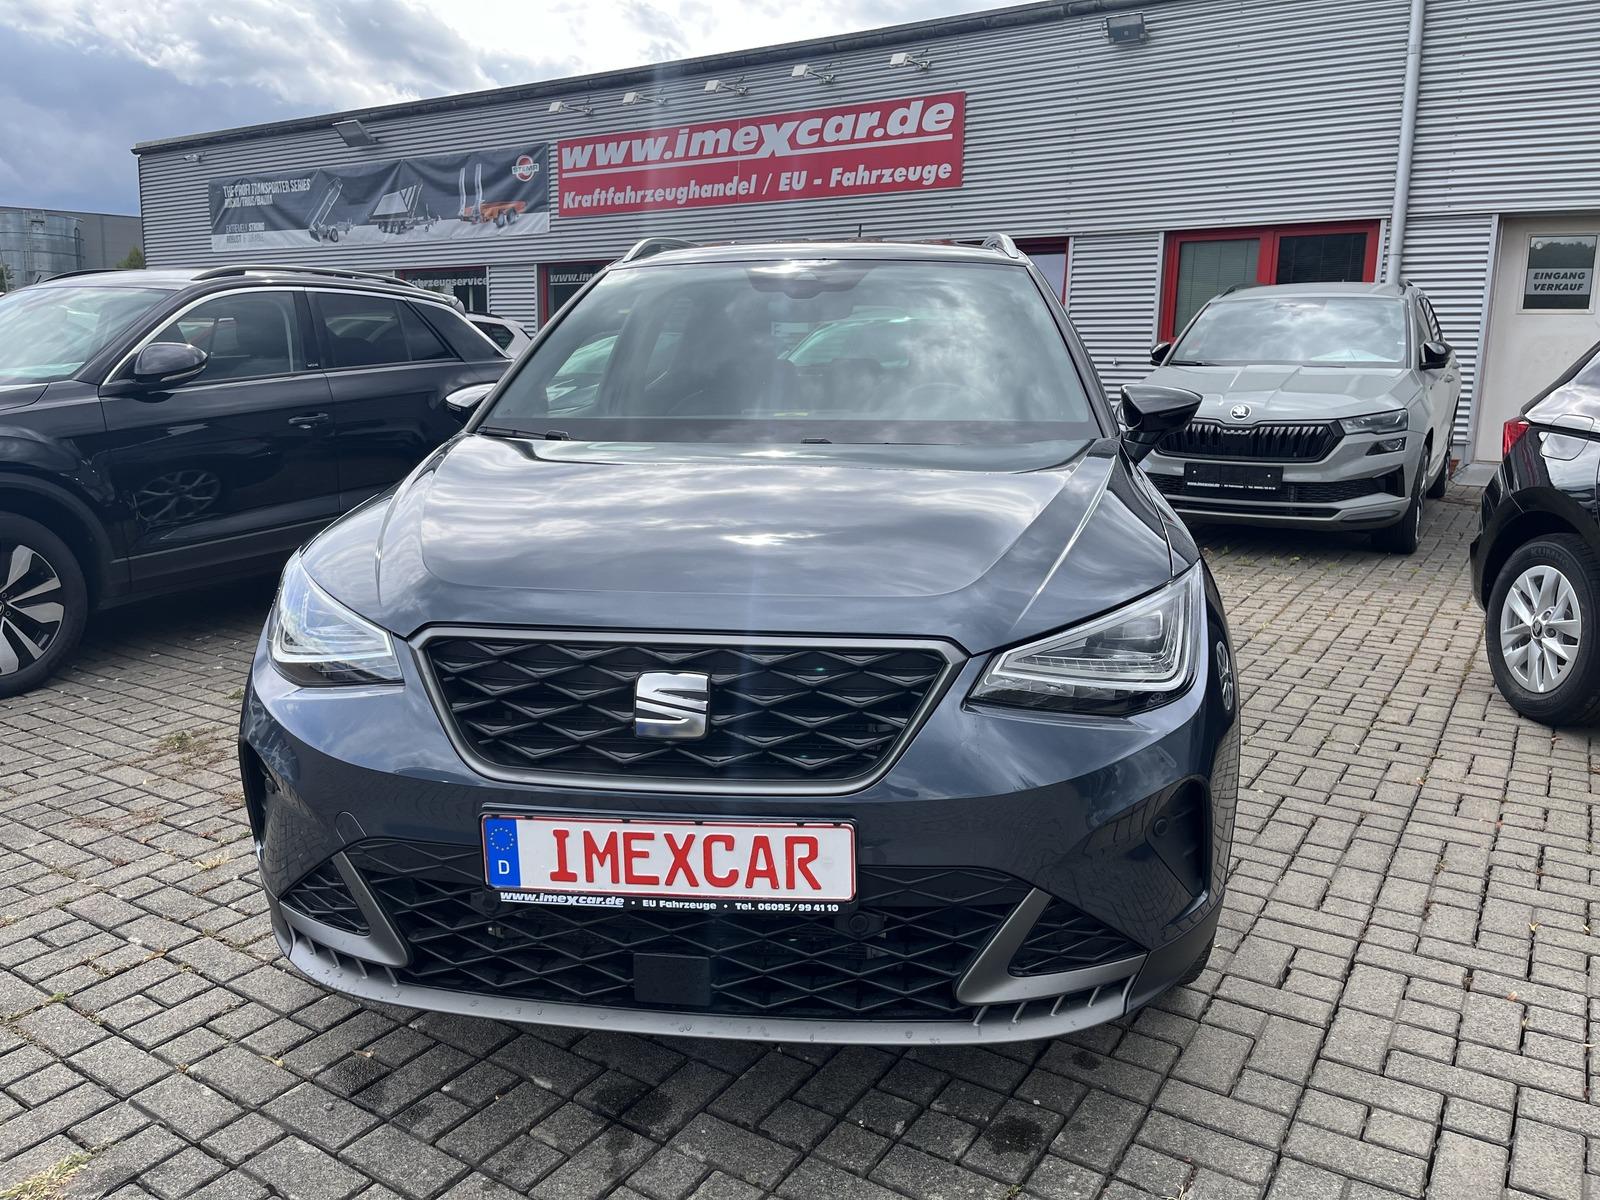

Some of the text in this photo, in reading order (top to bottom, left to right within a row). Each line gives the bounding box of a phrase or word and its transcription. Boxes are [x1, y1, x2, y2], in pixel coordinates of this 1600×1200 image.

[561, 100, 955, 170] www.imexcar.de
[562, 174, 757, 209] Kraftfahrzeughandel
[778, 170, 807, 192] EU
[829, 163, 952, 188] Fahrzeuge
[1533, 272, 1586, 280] EINGANG
[1533, 283, 1585, 291] VERKAUF
[498, 860, 510, 874] D
[549, 828, 822, 890] IMEXCAR
[500, 891, 625, 906] www.imexcar.de
[660, 900, 717, 911] Fahrzeuge
[735, 902, 755, 911] Tel.
